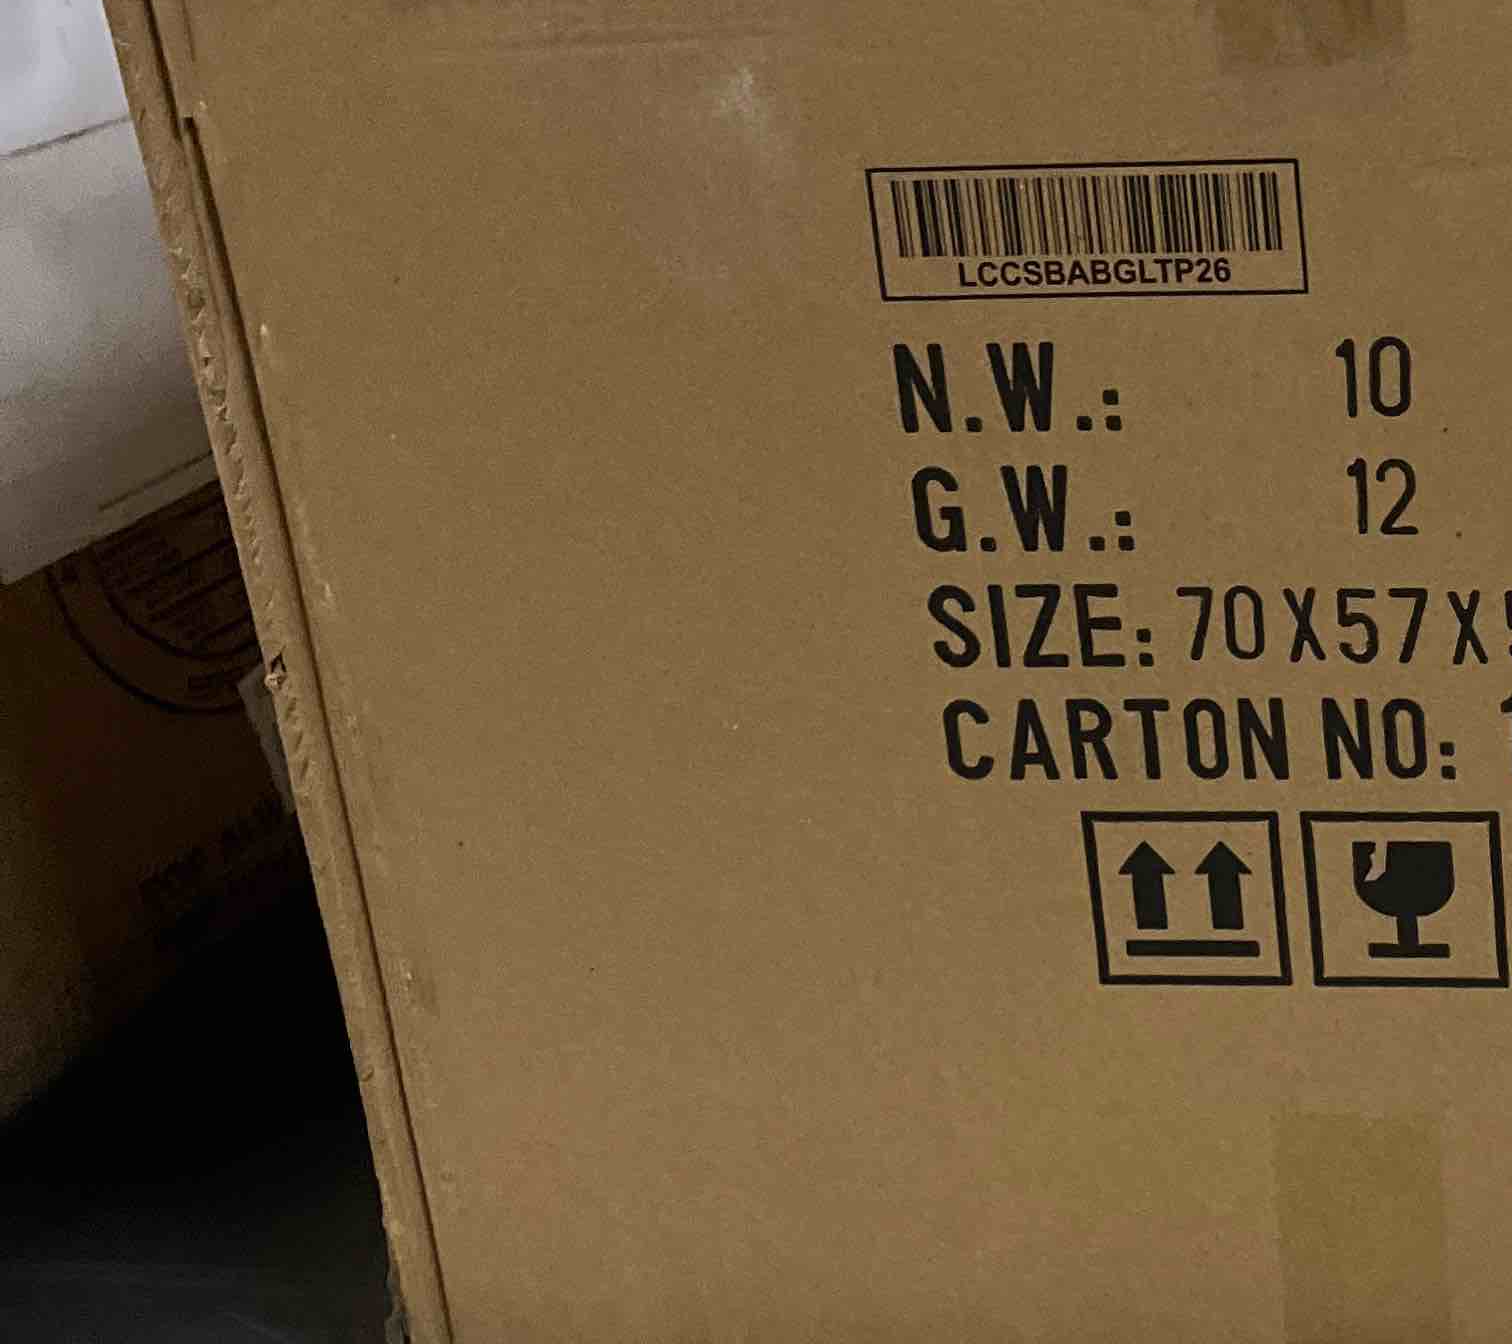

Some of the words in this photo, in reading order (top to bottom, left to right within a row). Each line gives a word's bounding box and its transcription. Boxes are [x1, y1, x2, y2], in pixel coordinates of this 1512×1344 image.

[957, 257, 1232, 288] LCCSBABGLTP26
[893, 342, 1123, 433] N.W.:
[1335, 336, 1412, 418] 10
[911, 464, 1135, 552] G.W.:
[1346, 457, 1419, 535] 12
[926, 584, 1154, 668] SIZE:
[942, 698, 1290, 780] CARTON
[1321, 698, 1457, 780] NO:
